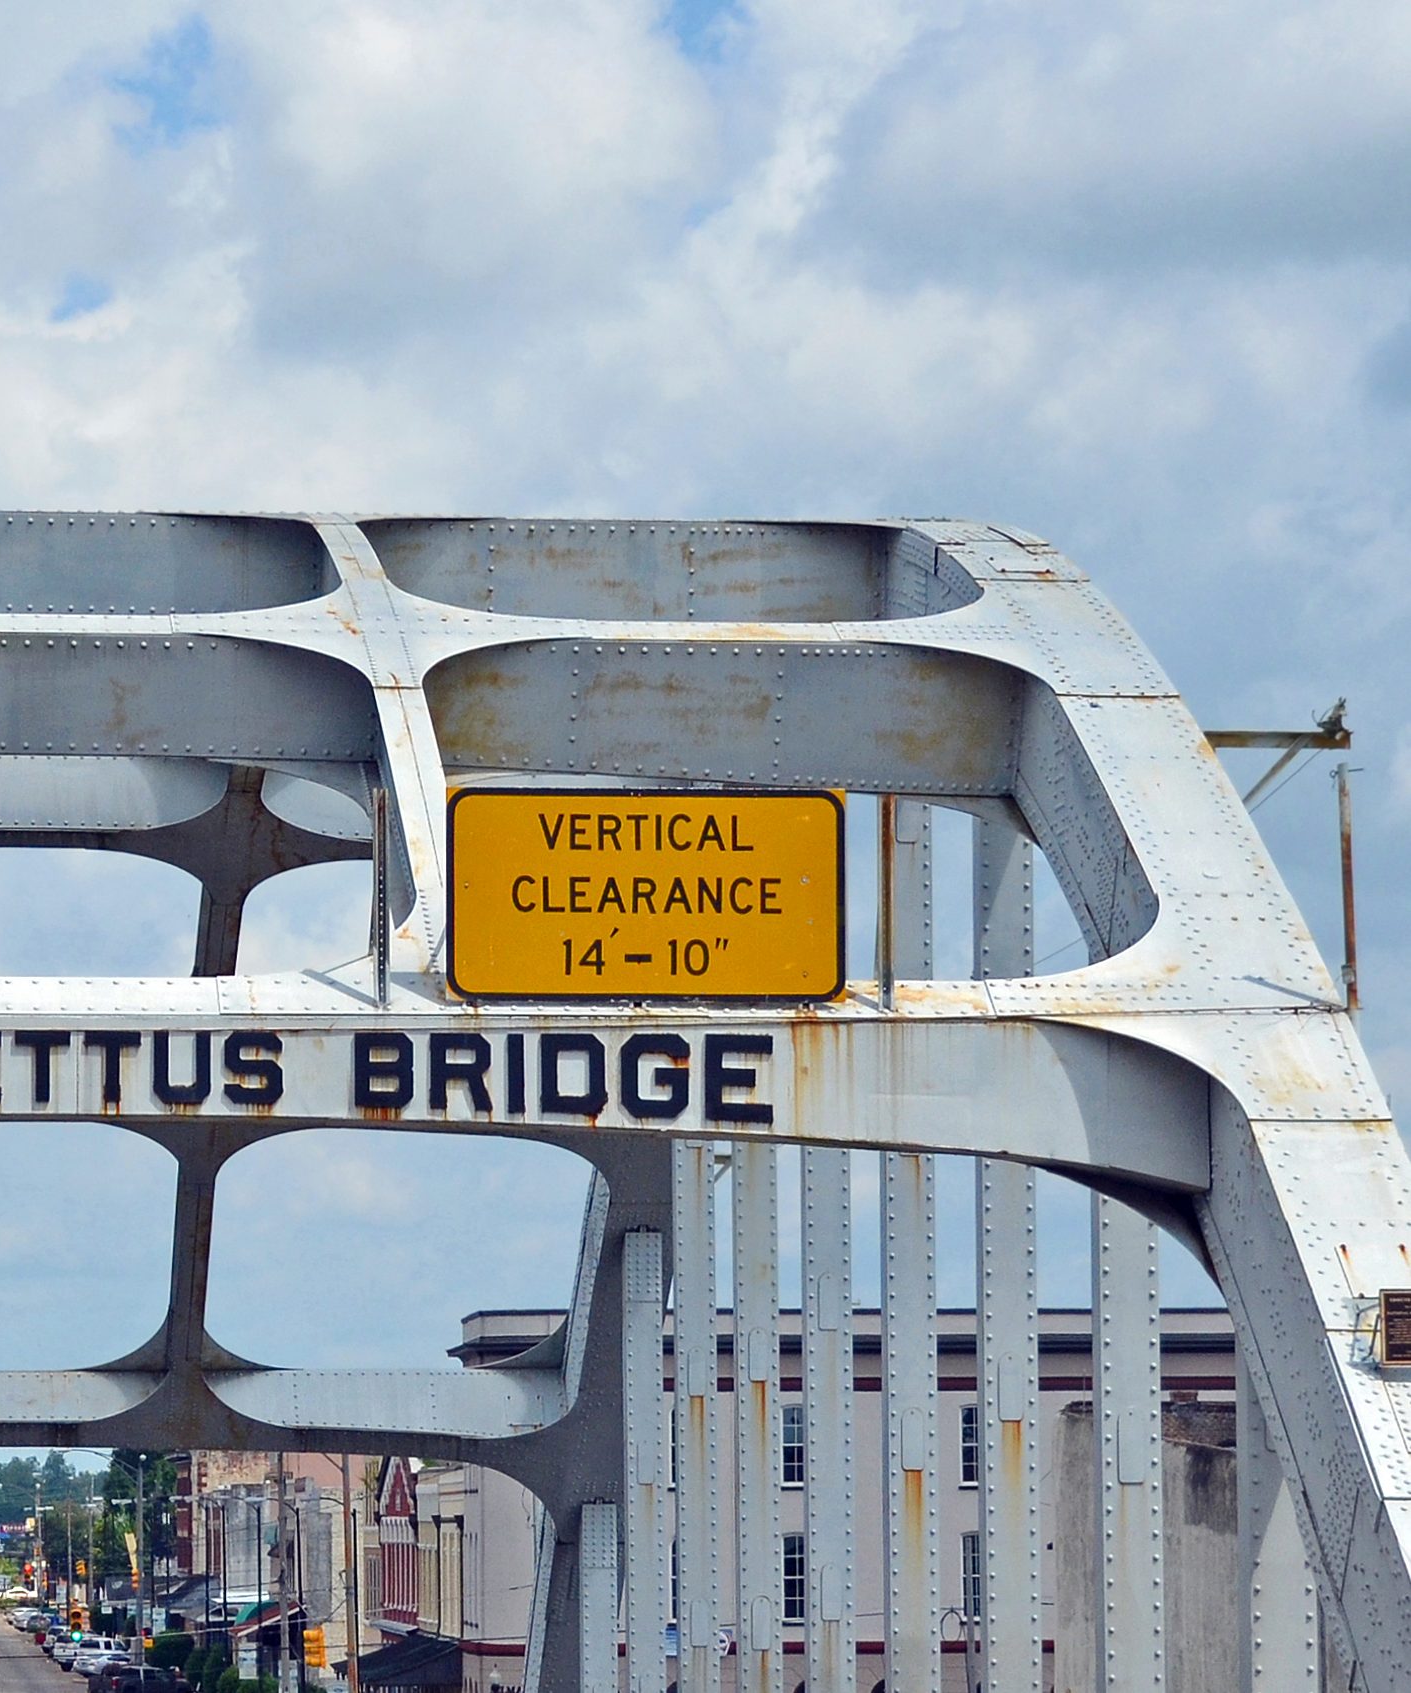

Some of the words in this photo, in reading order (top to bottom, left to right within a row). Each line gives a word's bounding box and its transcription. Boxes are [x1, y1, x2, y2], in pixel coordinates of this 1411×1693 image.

[538, 813, 754, 852] VERTICAL
[511, 874, 783, 915] CLEARANCE
[353, 1031, 774, 1124] BRIDGE
